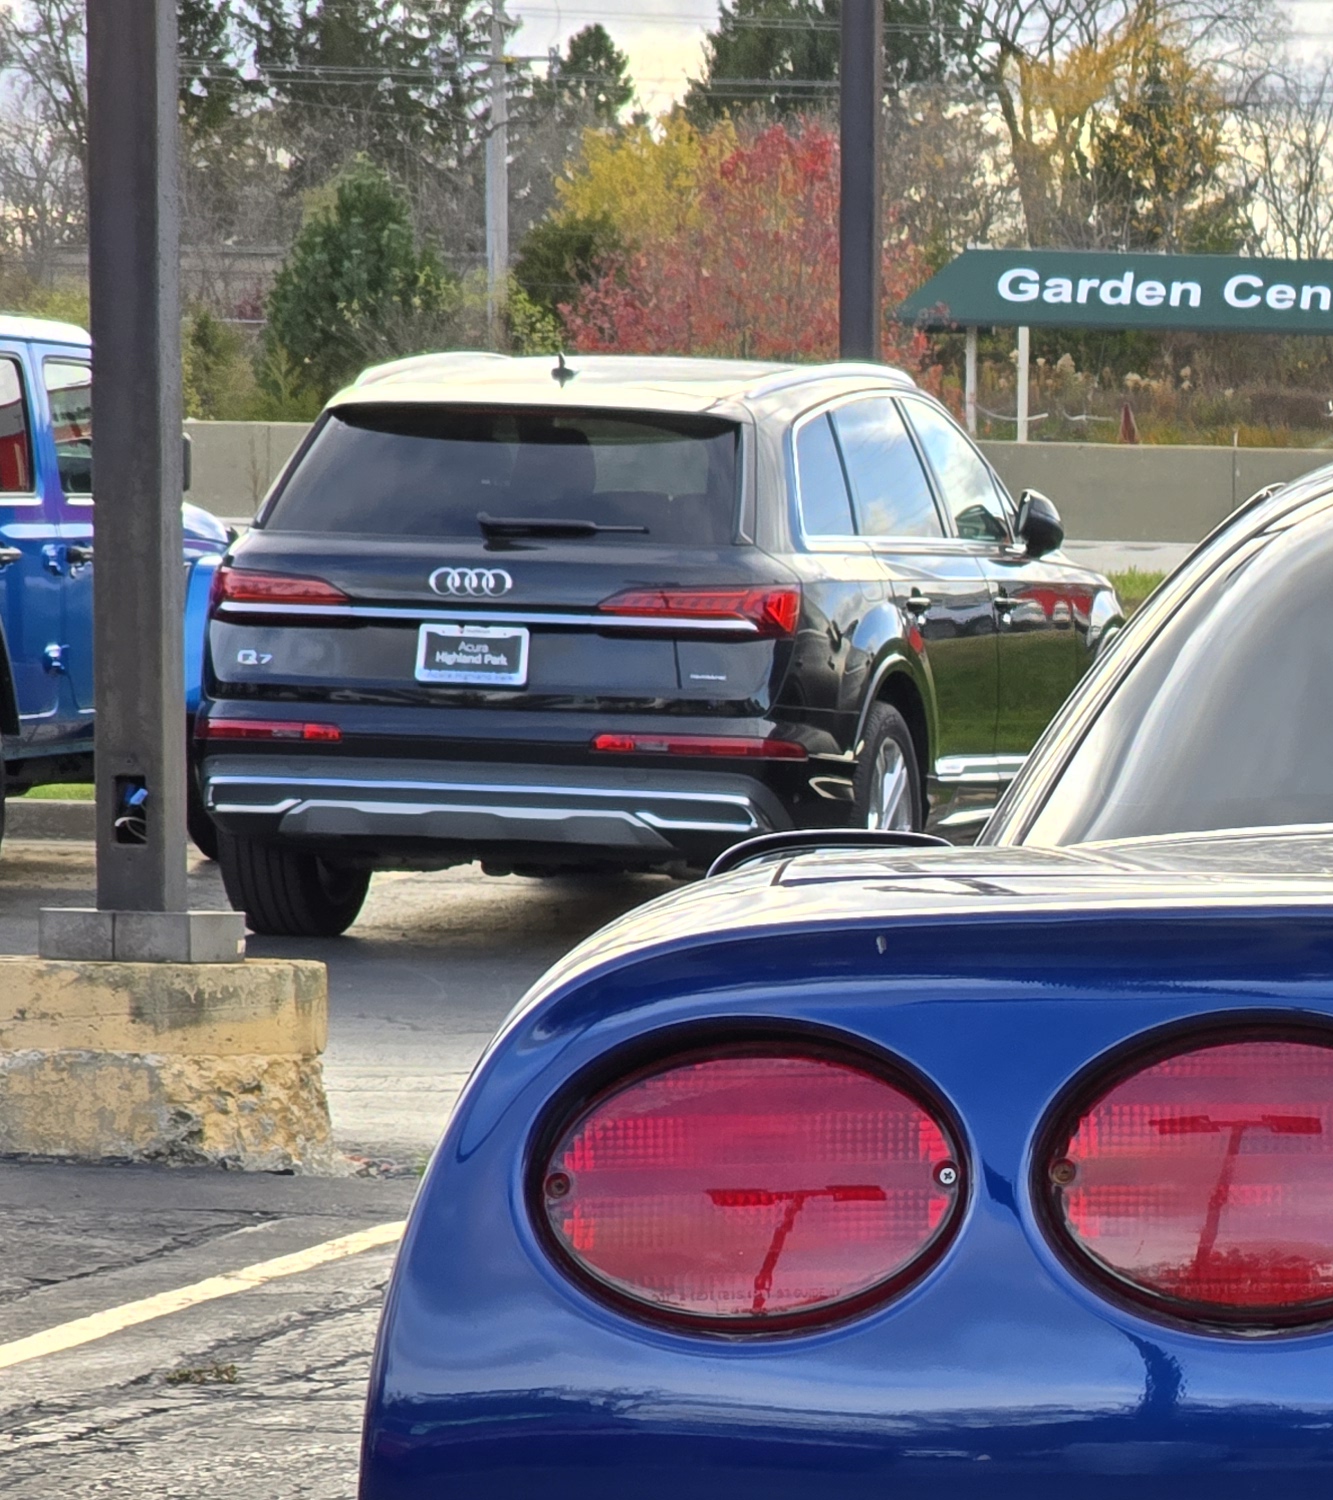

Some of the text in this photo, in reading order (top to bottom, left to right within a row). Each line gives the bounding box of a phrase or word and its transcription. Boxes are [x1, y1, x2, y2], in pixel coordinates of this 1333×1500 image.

[997, 268, 1202, 308] Garden
[458, 641, 489, 653] Acura
[237, 649, 273, 665] Q7
[435, 651, 508, 666] Highland Park
